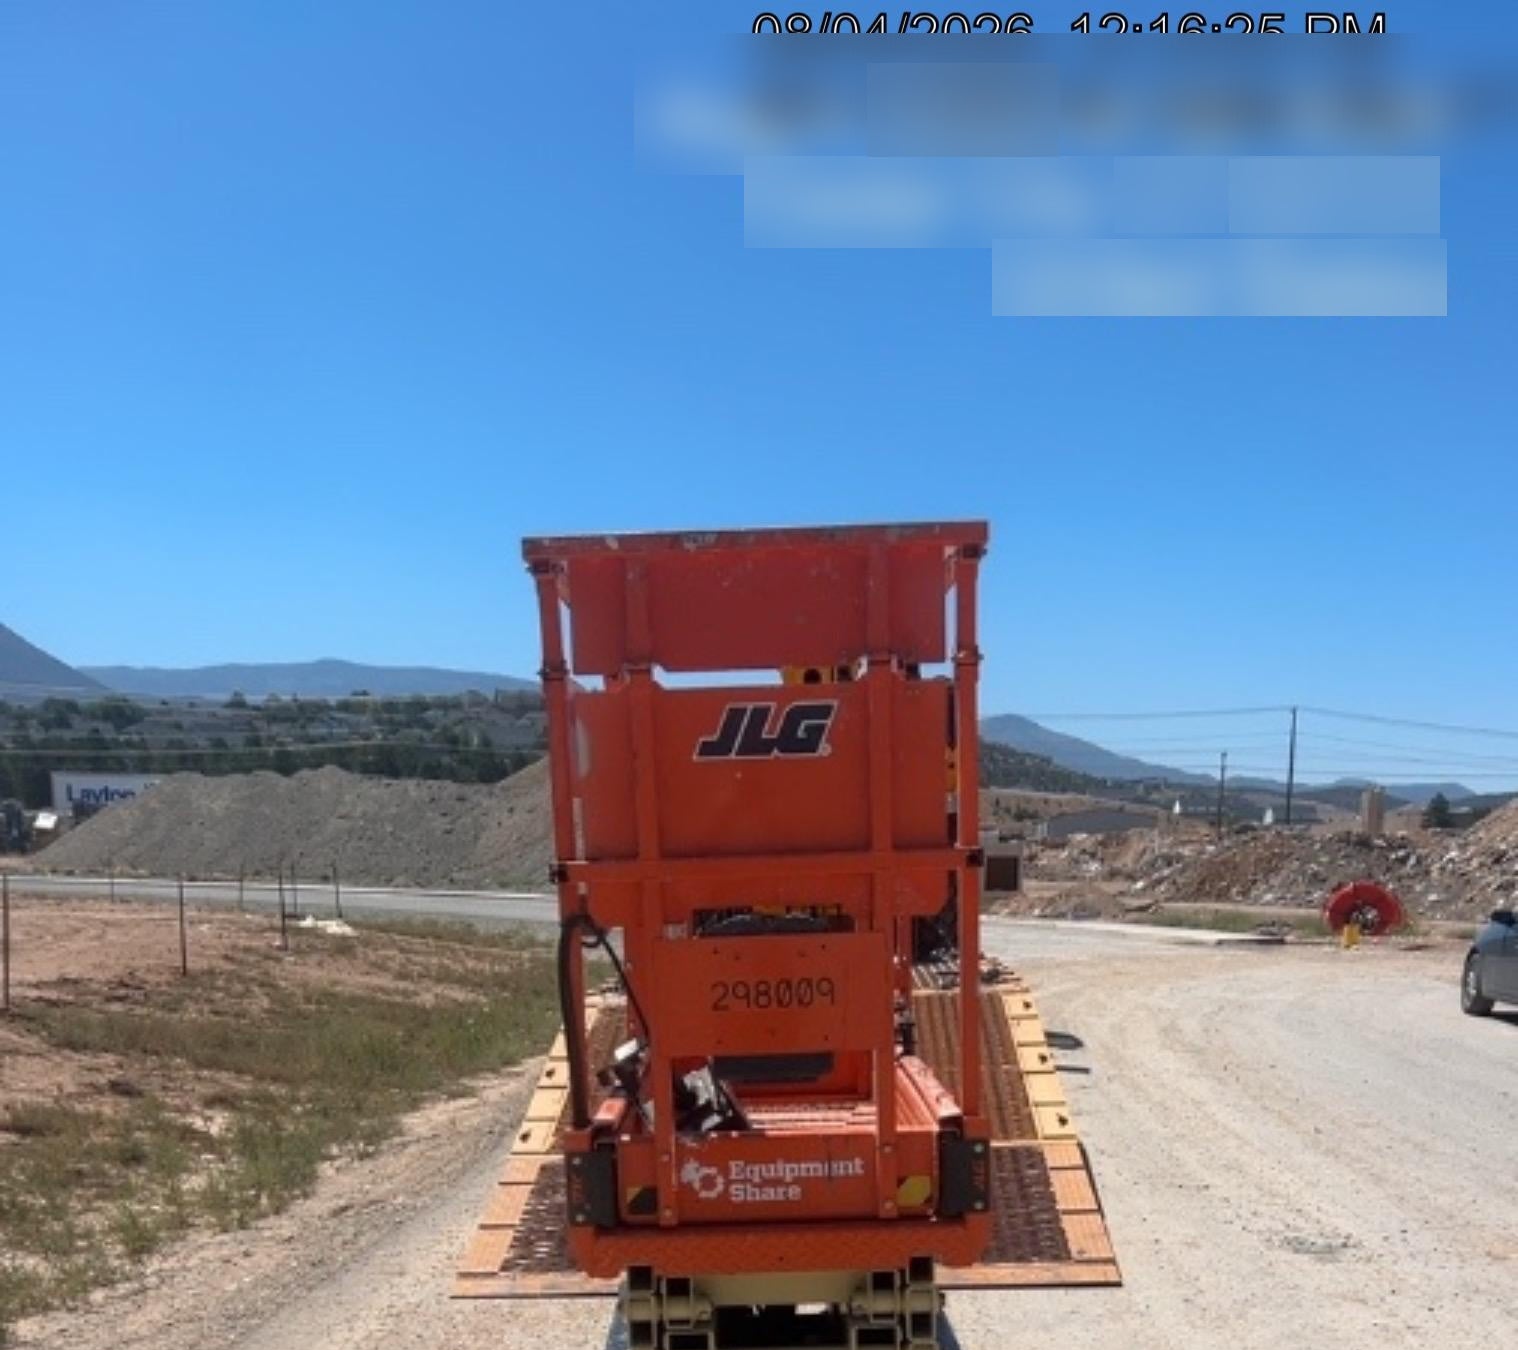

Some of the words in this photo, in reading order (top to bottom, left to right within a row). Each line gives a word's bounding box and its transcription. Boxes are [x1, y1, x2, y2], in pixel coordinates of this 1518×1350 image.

[693, 700, 838, 760] JLG
[711, 977, 835, 1011] 298009
[729, 1183, 802, 1201] Share
